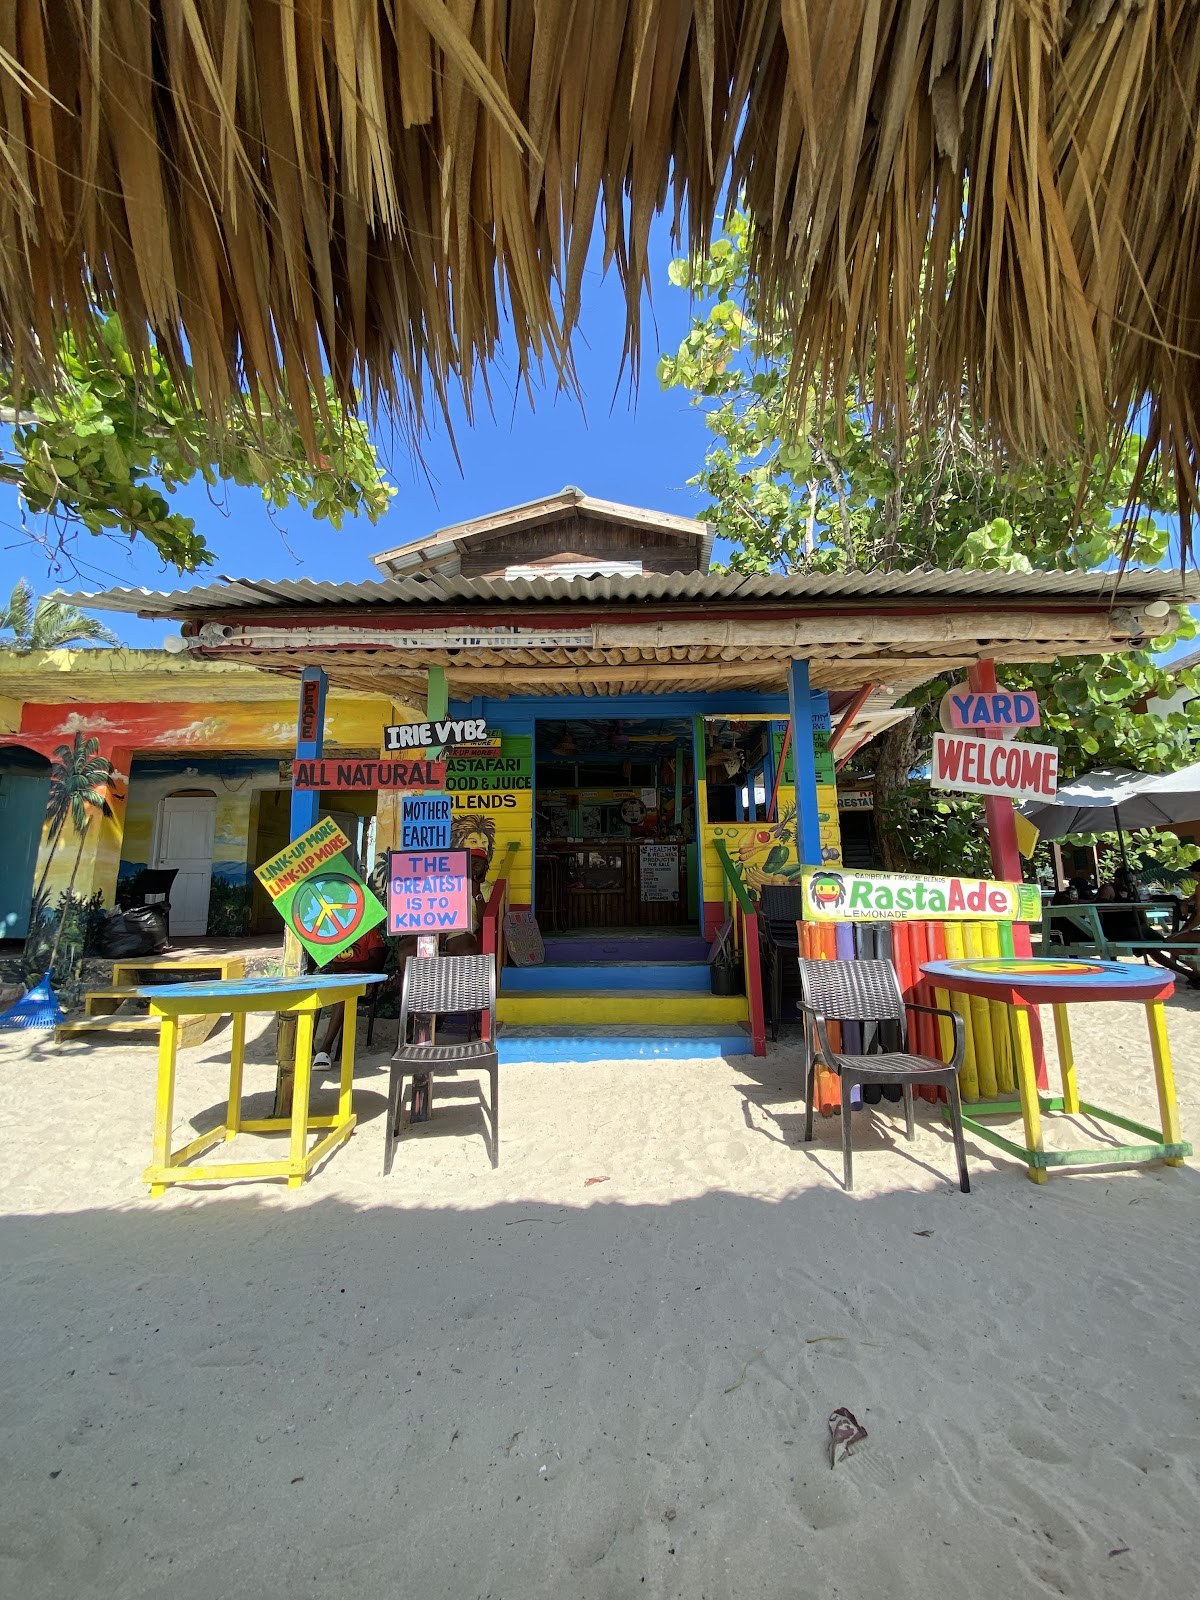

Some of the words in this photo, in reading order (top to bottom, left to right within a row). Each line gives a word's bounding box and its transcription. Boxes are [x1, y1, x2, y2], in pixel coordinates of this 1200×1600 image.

[302, 682, 316, 739] PEACE
[952, 694, 1035, 724] YARD
[387, 723, 432, 749] IRIE
[435, 719, 487, 743] VYBZ
[296, 763, 331, 786] ALL
[337, 762, 440, 786] NATURAL
[446, 758, 521, 772] ASTAFARI
[937, 738, 1057, 795] WELCOME
[446, 777, 478, 791] OOD
[481, 777, 490, 790] &
[492, 776, 532, 790] JUICE
[403, 801, 449, 821] MOTHER
[402, 825, 446, 848] EARTH
[259, 841, 307, 882] LINK-UP
[305, 820, 337, 848] MORE
[268, 855, 316, 896] LINK-UP
[313, 834, 348, 862] MORE
[408, 856, 451, 873] THE
[392, 875, 465, 895] GREATEST
[855, 872, 892, 881] CARIBBEAN
[894, 874, 922, 882] TROPICAL
[923, 876, 946, 884] BLENDS
[407, 897, 422, 911] IS
[427, 897, 449, 910] TO
[849, 879, 1009, 913] RastaAde
[395, 910, 458, 928] KNOW
[844, 910, 908, 919] LEMONADE
